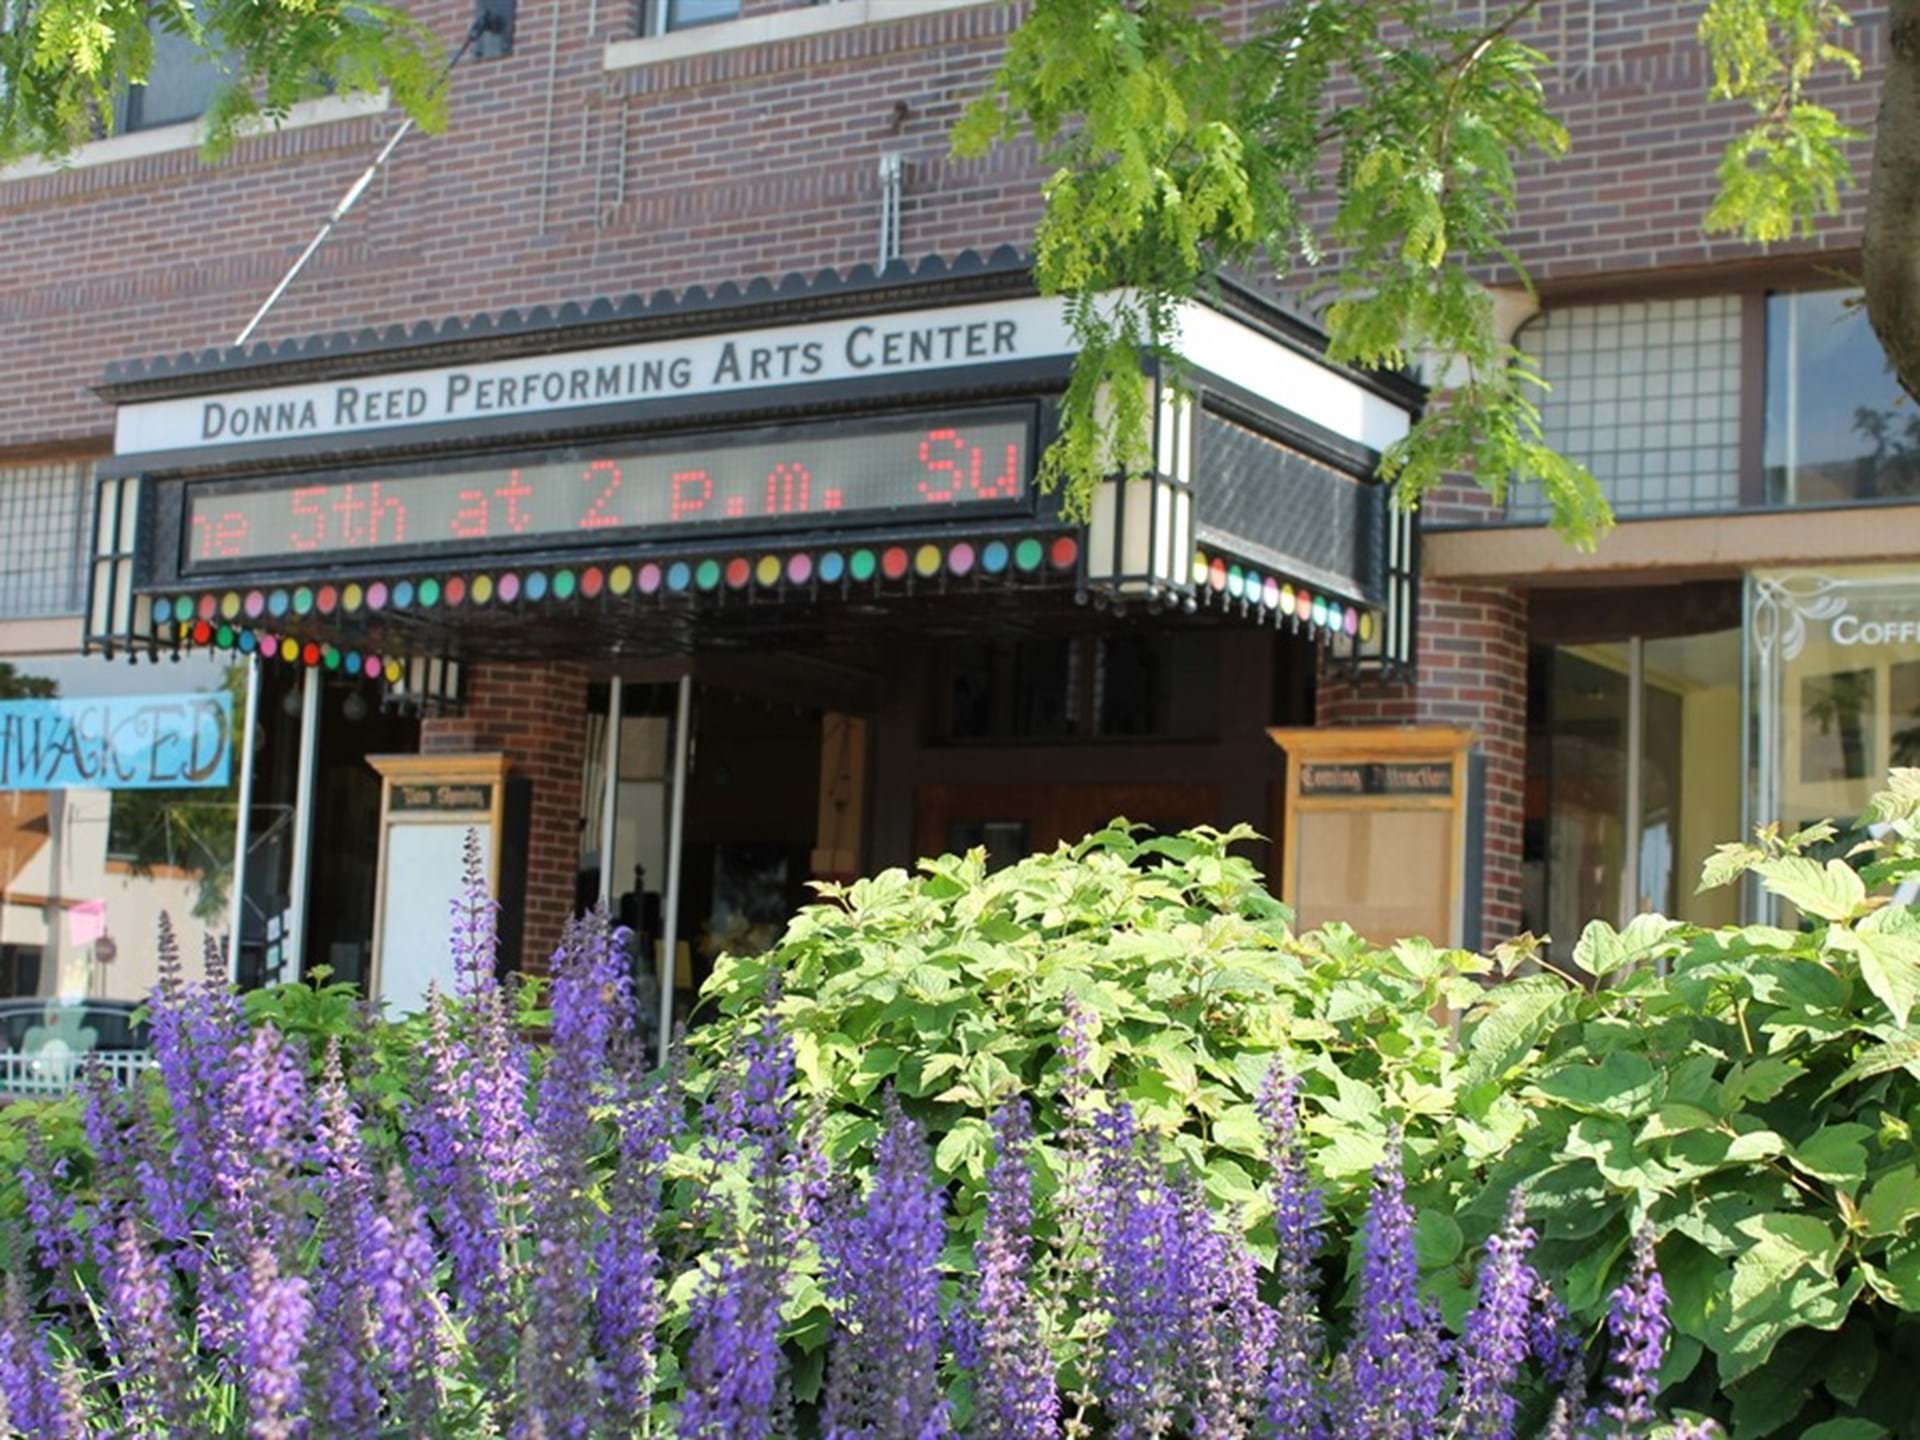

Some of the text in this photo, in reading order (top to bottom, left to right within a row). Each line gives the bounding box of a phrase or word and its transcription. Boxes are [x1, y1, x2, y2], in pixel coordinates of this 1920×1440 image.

[201, 319, 1018, 440] DONNA REED PERFORMING ARTS CENTER
[290, 480, 407, 550] 5th
[450, 467, 532, 538] at
[579, 458, 623, 529] 2
[670, 462, 845, 521] p.m.
[916, 427, 1019, 504] Su
